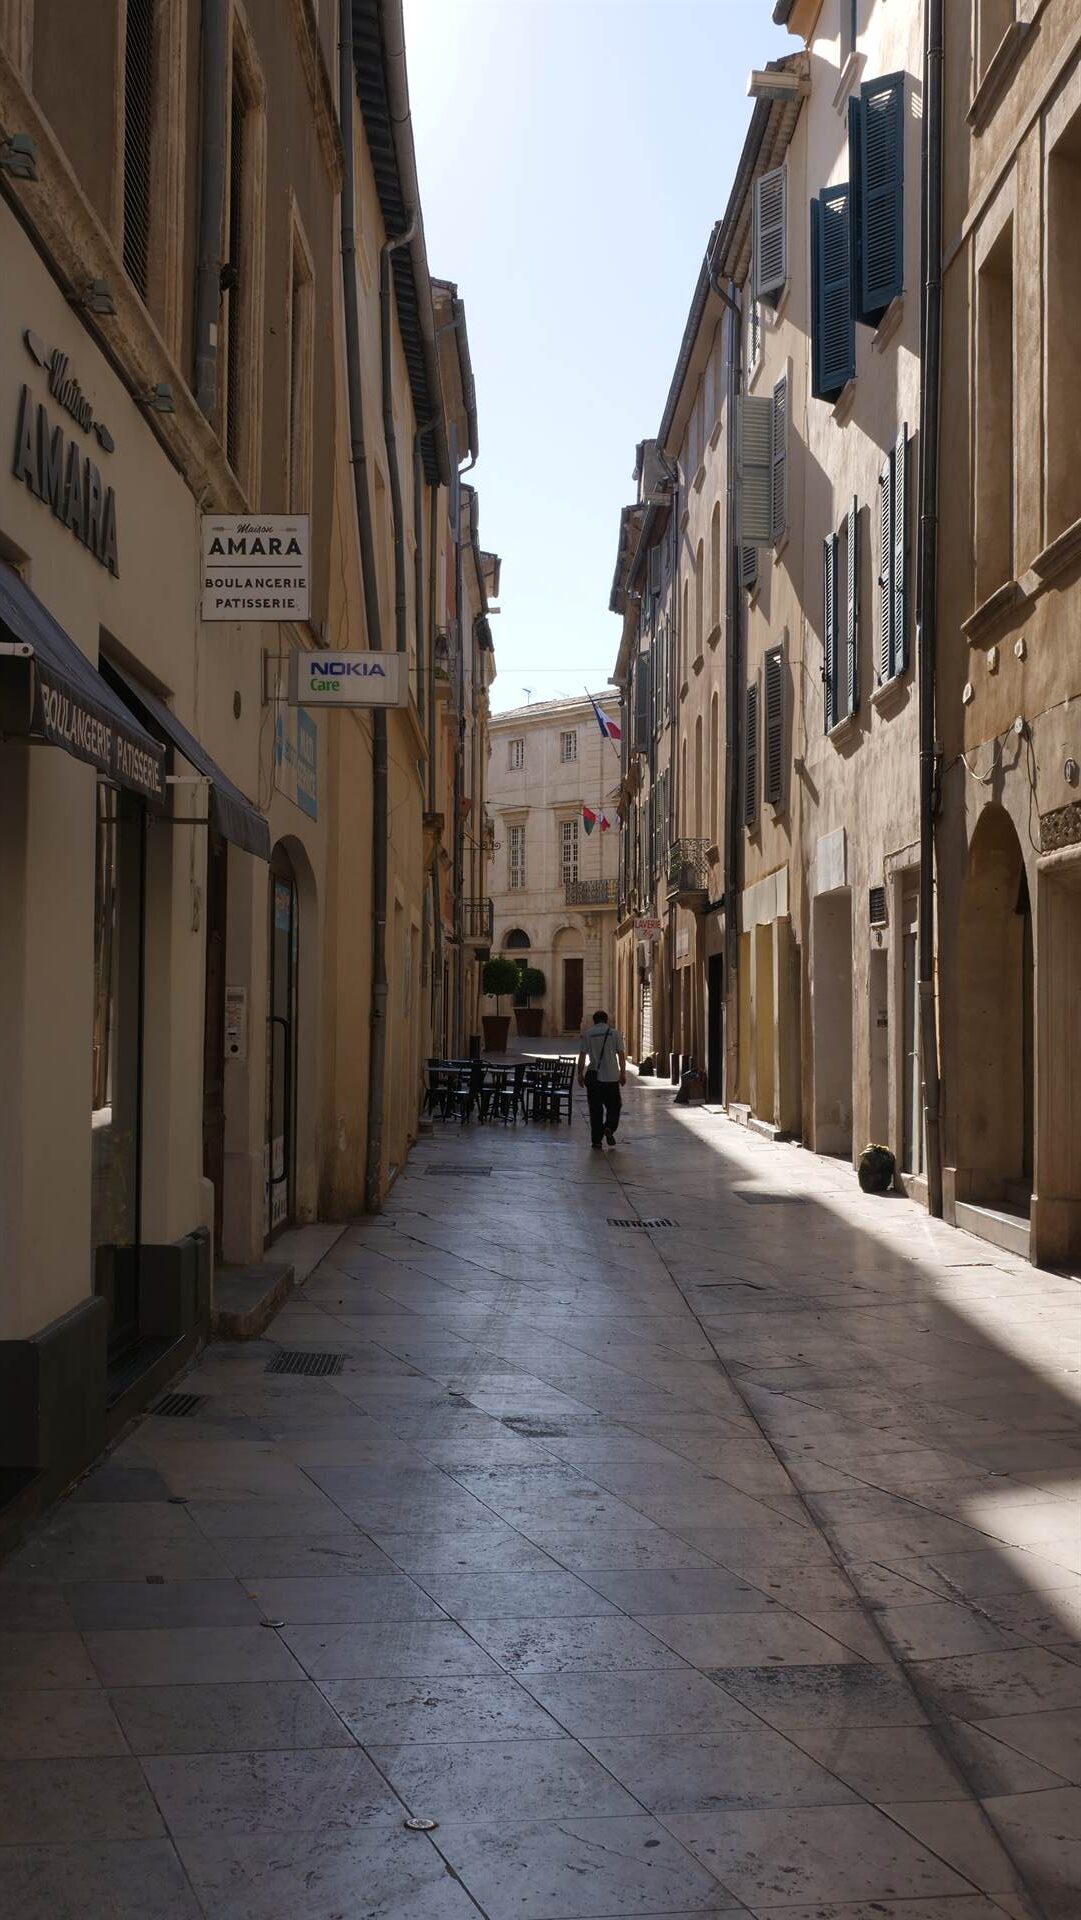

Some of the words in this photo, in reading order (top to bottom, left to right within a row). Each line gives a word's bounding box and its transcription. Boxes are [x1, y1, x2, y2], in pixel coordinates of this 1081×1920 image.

[13, 383, 119, 579] AMARA
[235, 523, 274, 534] Maison
[208, 537, 303, 556] AMARA
[205, 578, 307, 589] BOULANGERIE
[216, 598, 295, 608] PATISSERIE
[310, 662, 386, 677] NOKIA
[310, 678, 340, 692] Care
[41, 683, 112, 765] BOULANGERIE
[117, 735, 162, 793] PATISSERIE
[635, 920, 661, 929] LAVERIE
